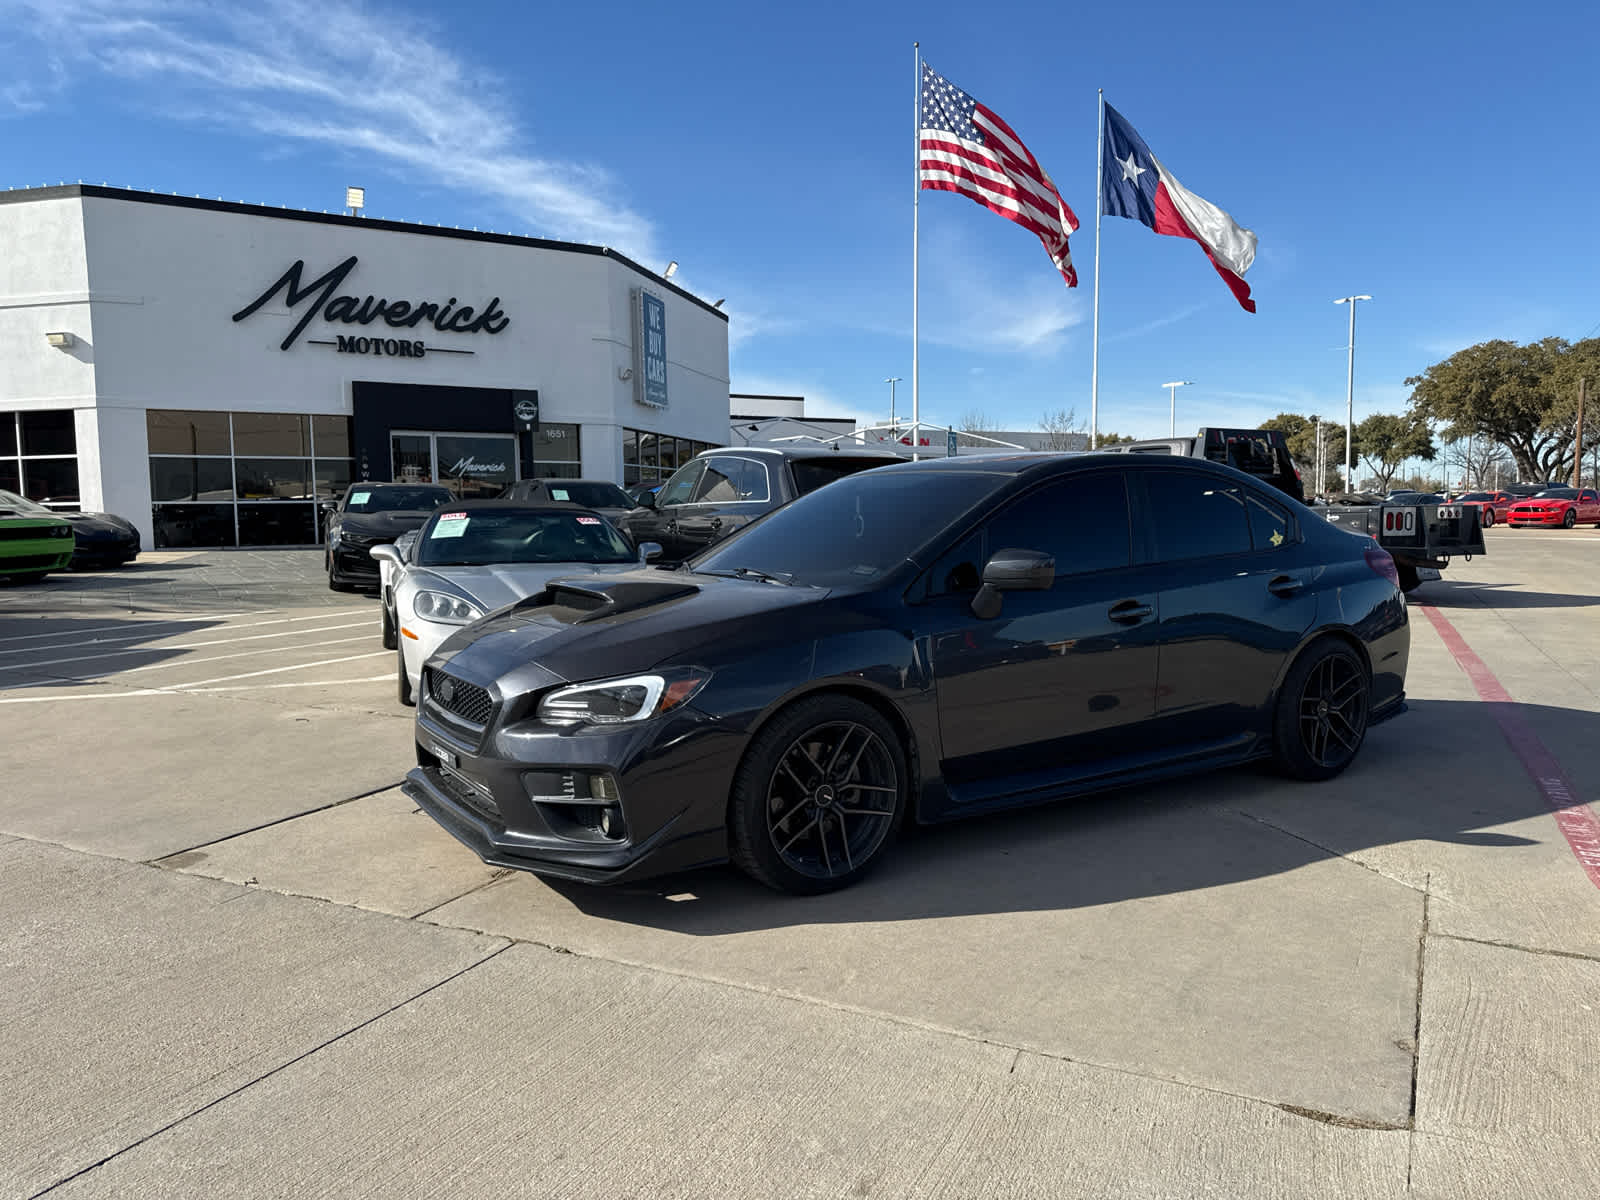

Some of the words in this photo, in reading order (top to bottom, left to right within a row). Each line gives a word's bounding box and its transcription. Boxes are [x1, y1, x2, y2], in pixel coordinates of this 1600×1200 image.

[232, 256, 510, 351] Maverick
[649, 303, 660, 329] WE
[336, 335, 426, 358] MOTORS
[649, 330, 661, 355] BUY
[648, 357, 664, 383] CARS
[449, 456, 505, 477] Maverick
